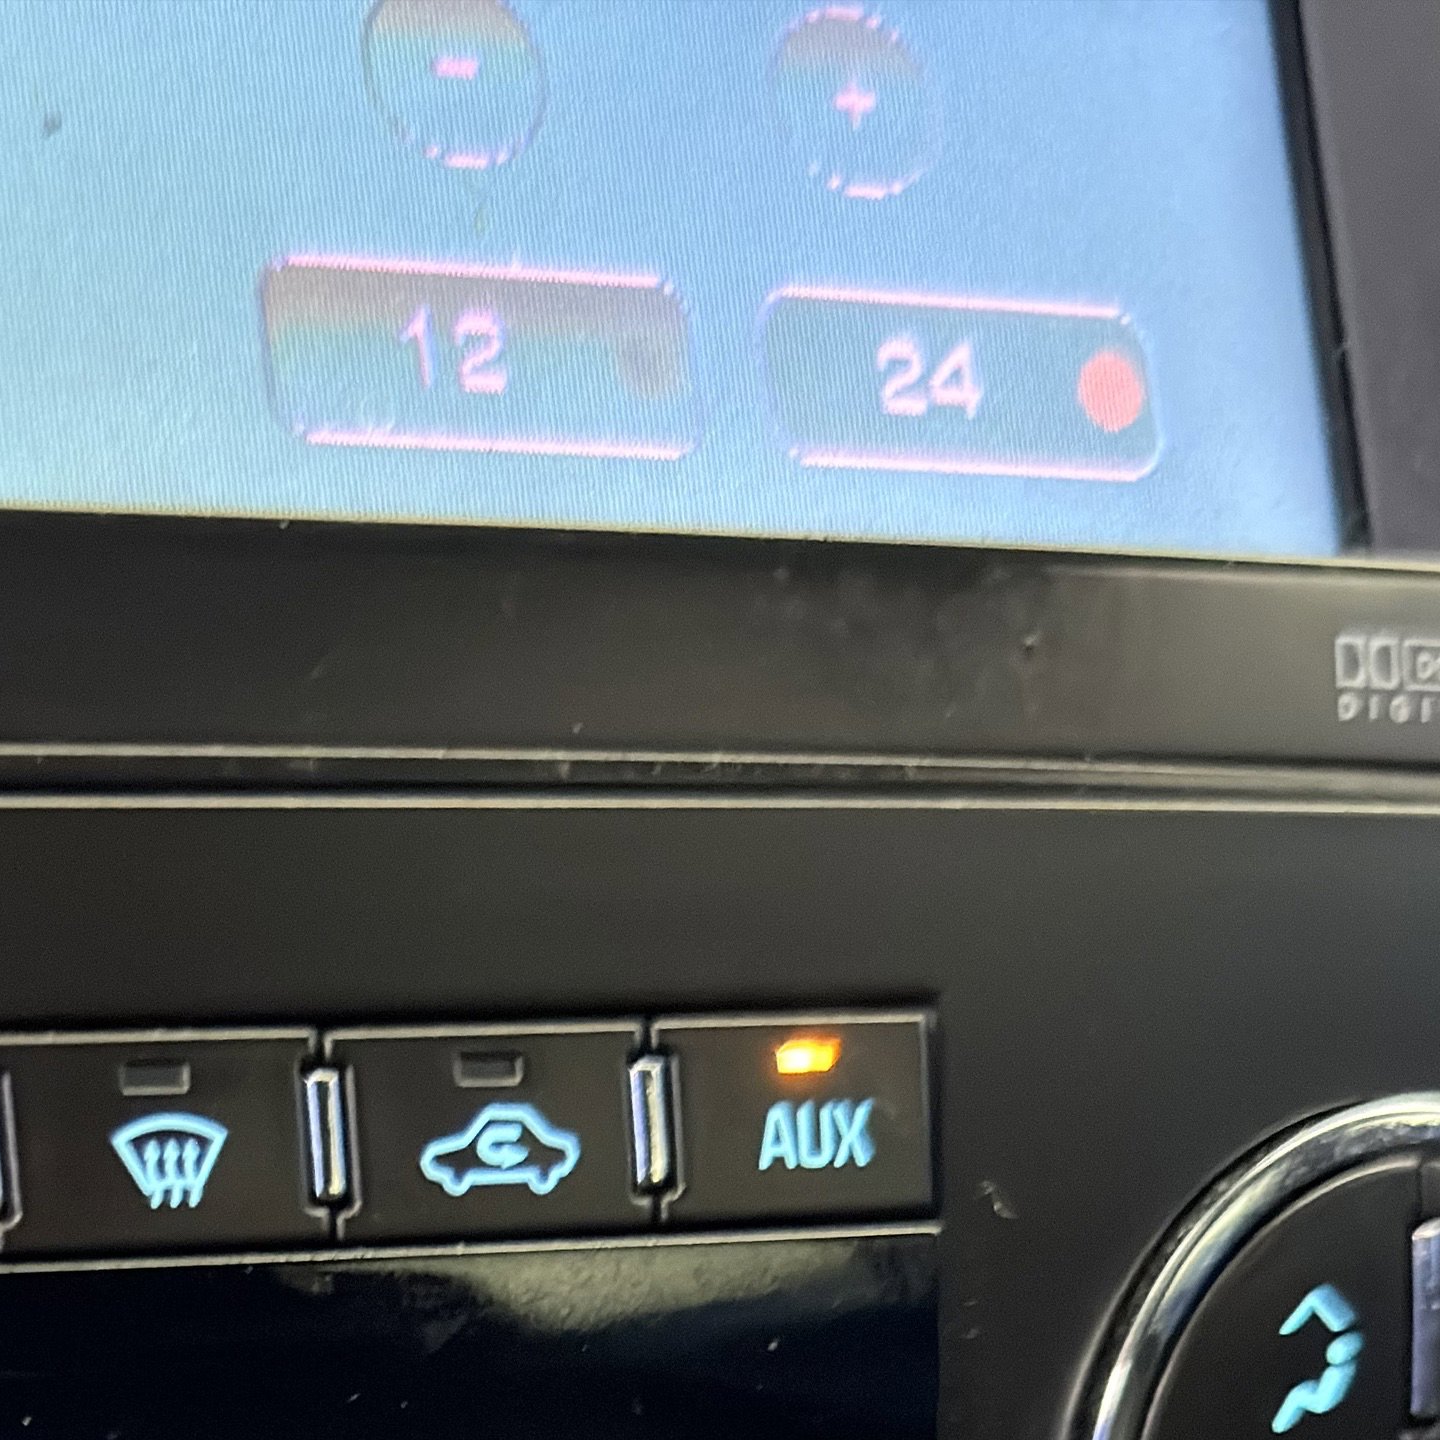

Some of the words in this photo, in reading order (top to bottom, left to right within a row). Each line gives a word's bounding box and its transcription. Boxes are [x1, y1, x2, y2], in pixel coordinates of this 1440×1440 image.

[400, 304, 506, 394] 12
[875, 336, 981, 418] 24
[757, 1098, 877, 1171] AUX
